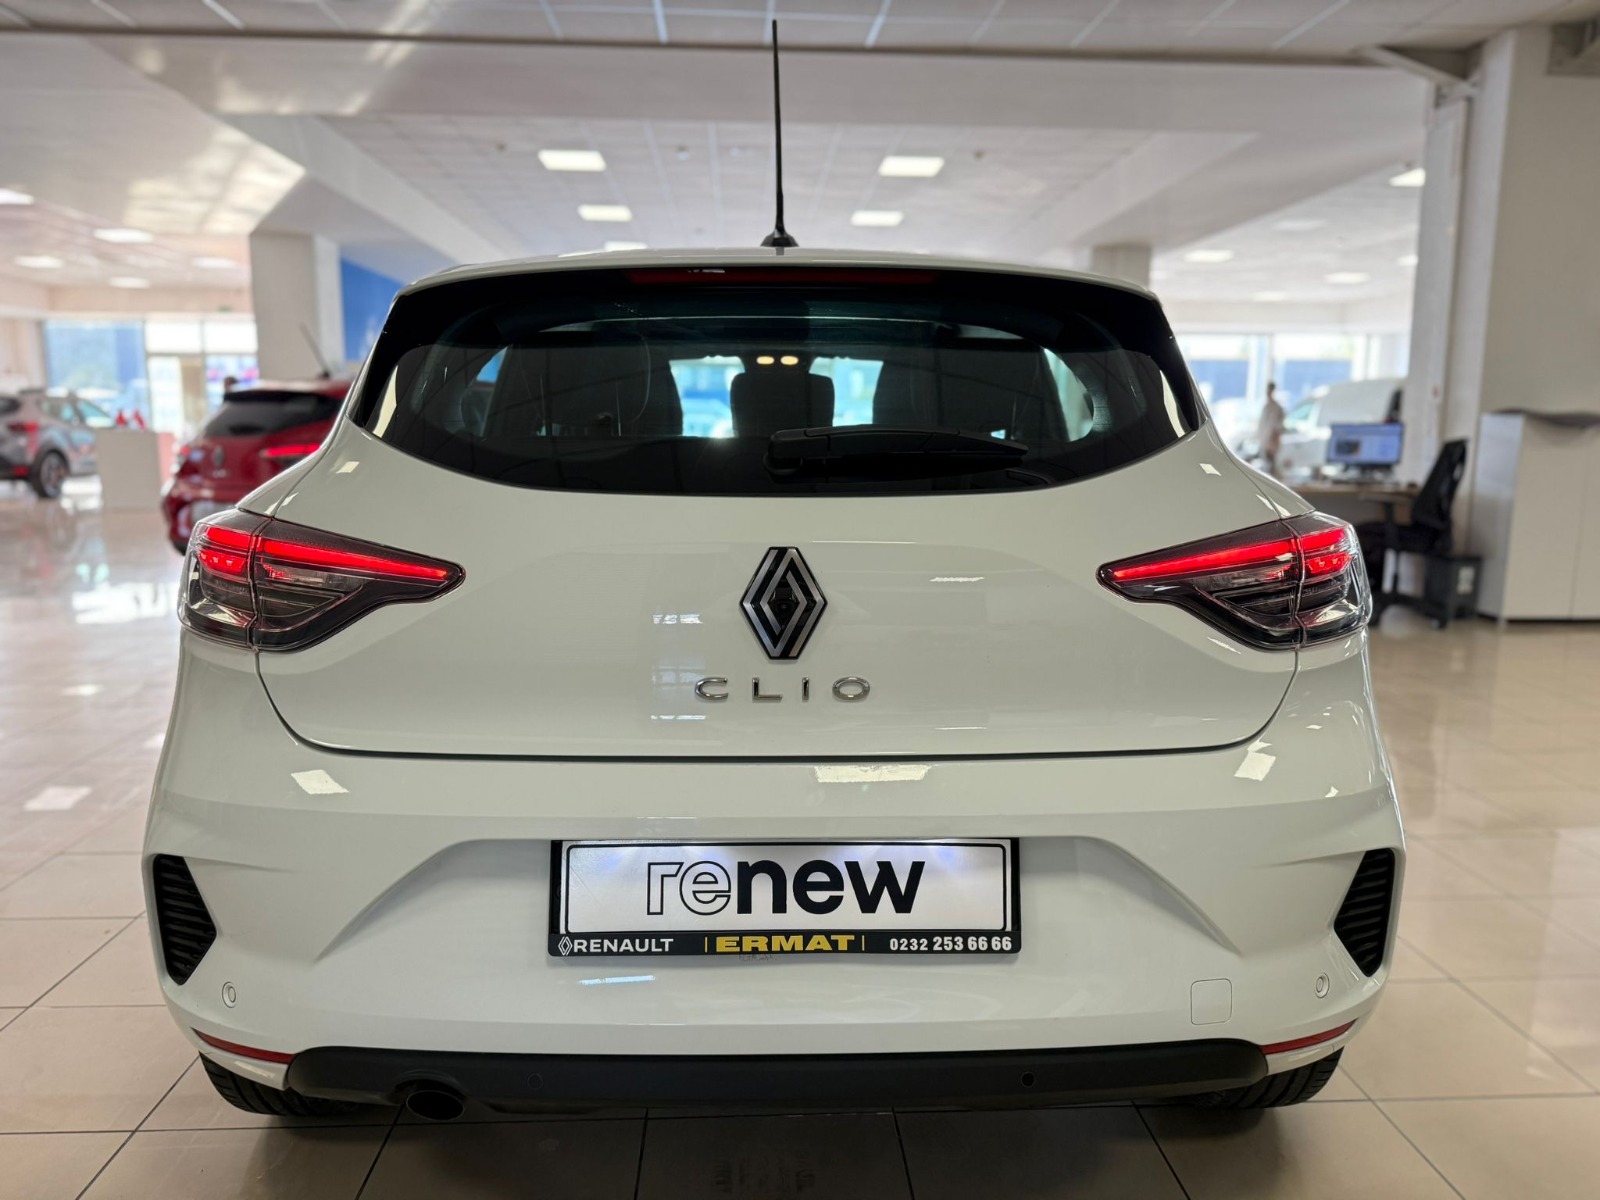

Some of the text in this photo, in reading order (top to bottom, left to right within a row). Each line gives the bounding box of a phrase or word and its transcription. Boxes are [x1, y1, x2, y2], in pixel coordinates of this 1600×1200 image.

[695, 676, 870, 702] CLIO
[647, 860, 925, 916] renew
[573, 938, 674, 953] RENAULT
[715, 934, 855, 953] ERMAT
[889, 936, 1012, 951] 0232 253 66 66
